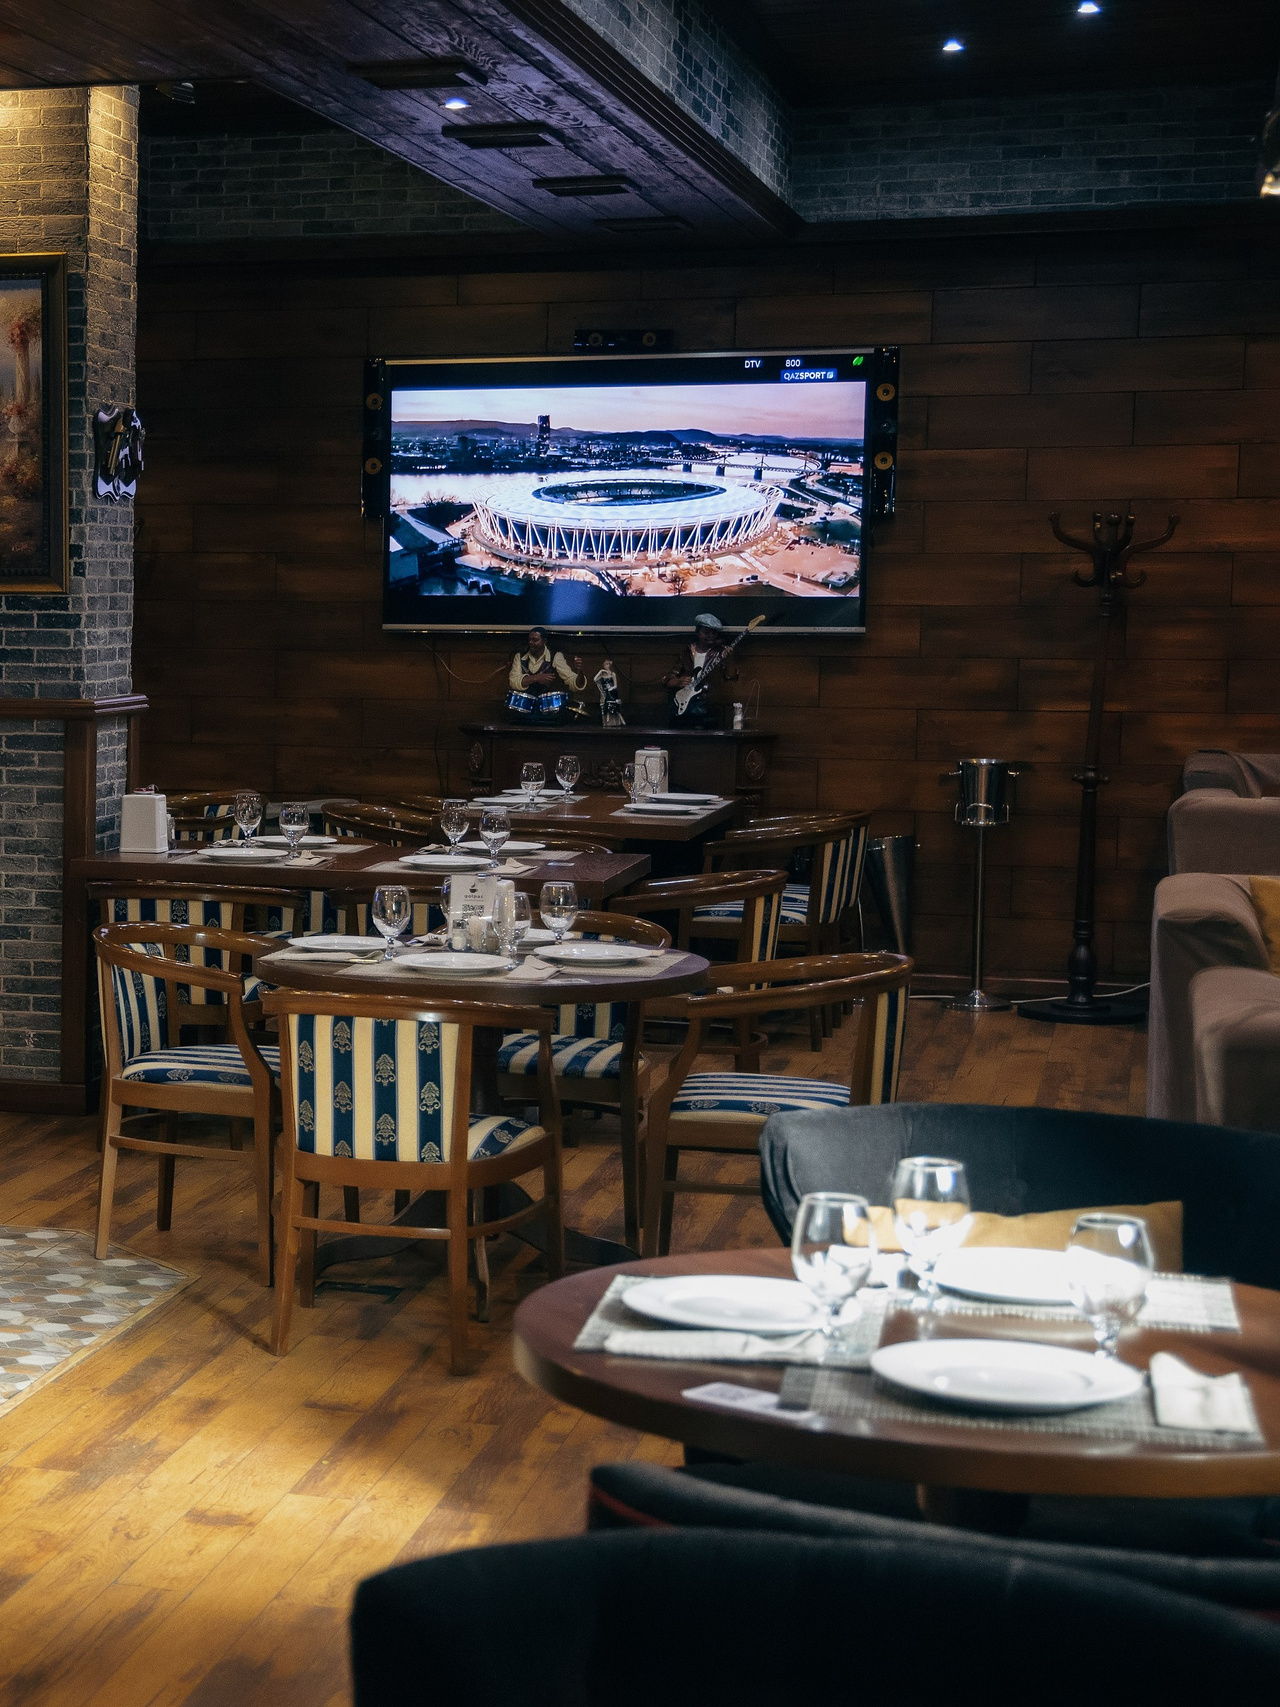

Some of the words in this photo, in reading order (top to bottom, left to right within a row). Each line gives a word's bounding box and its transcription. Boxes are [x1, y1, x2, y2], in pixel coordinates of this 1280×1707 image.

[744, 360, 761, 368] DTV
[785, 359, 801, 367] 800
[783, 371, 826, 381] QAZSPORT
